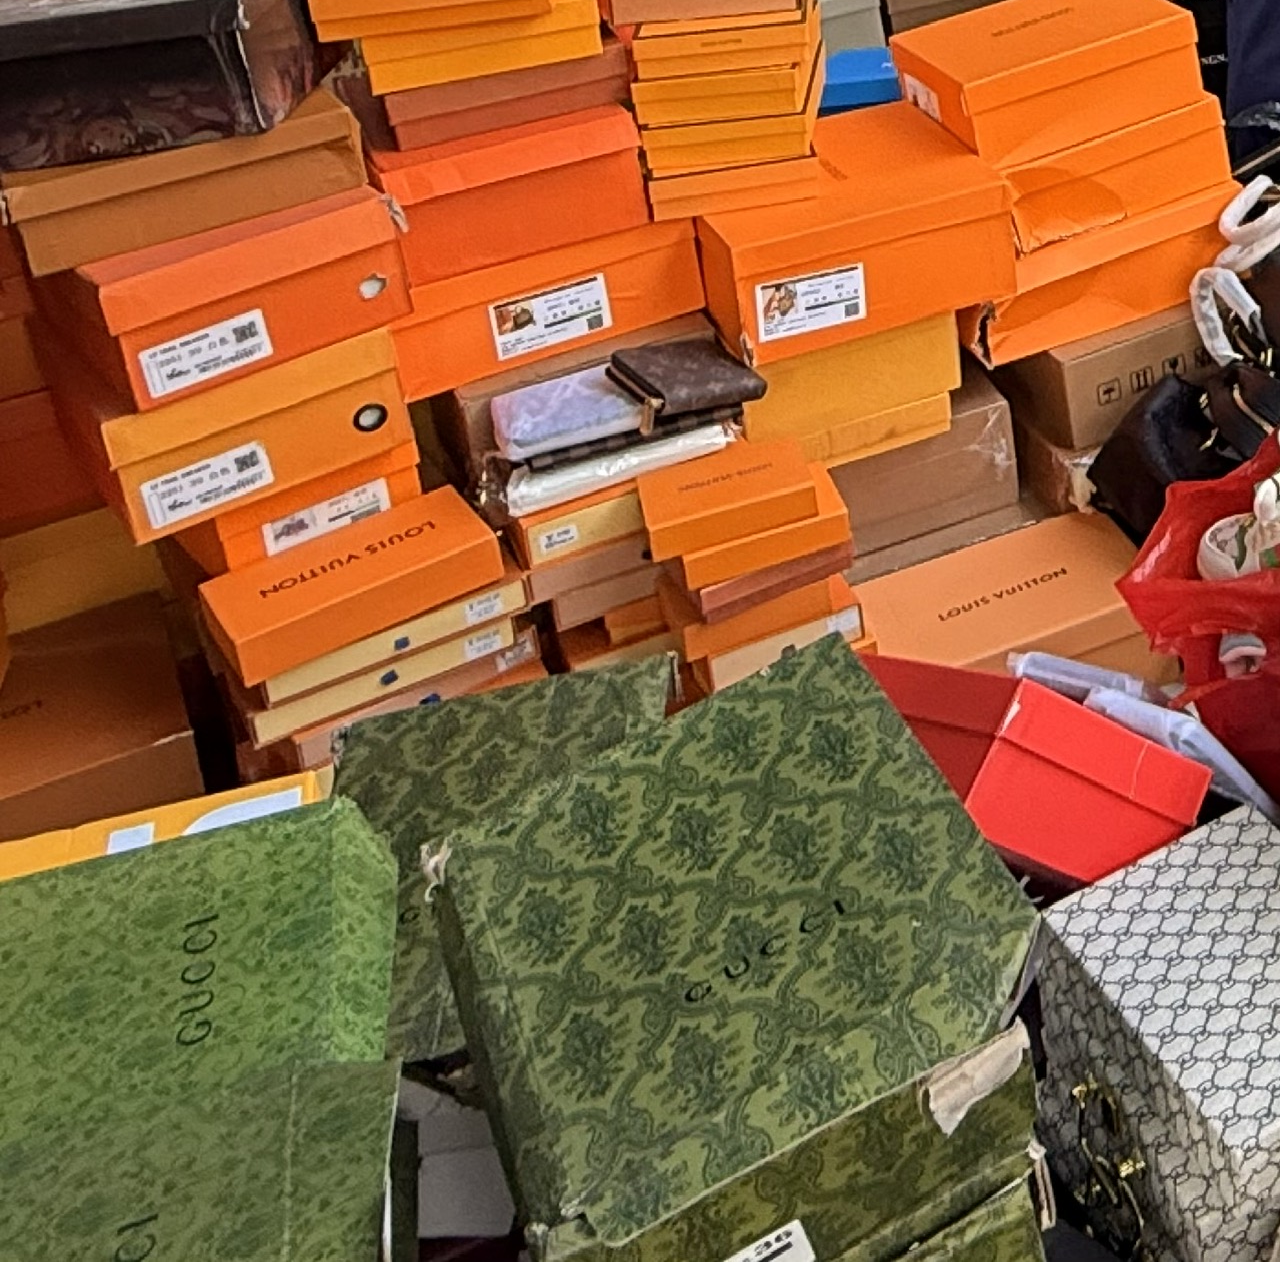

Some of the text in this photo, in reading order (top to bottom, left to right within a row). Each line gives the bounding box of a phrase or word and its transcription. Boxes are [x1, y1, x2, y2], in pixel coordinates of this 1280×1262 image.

[259, 520, 436, 599] LOUIS VUITTON
[937, 567, 1068, 622] LOUIS VUITTON
[177, 914, 219, 1046] GUCCI
[685, 900, 845, 1002] GUCCI
